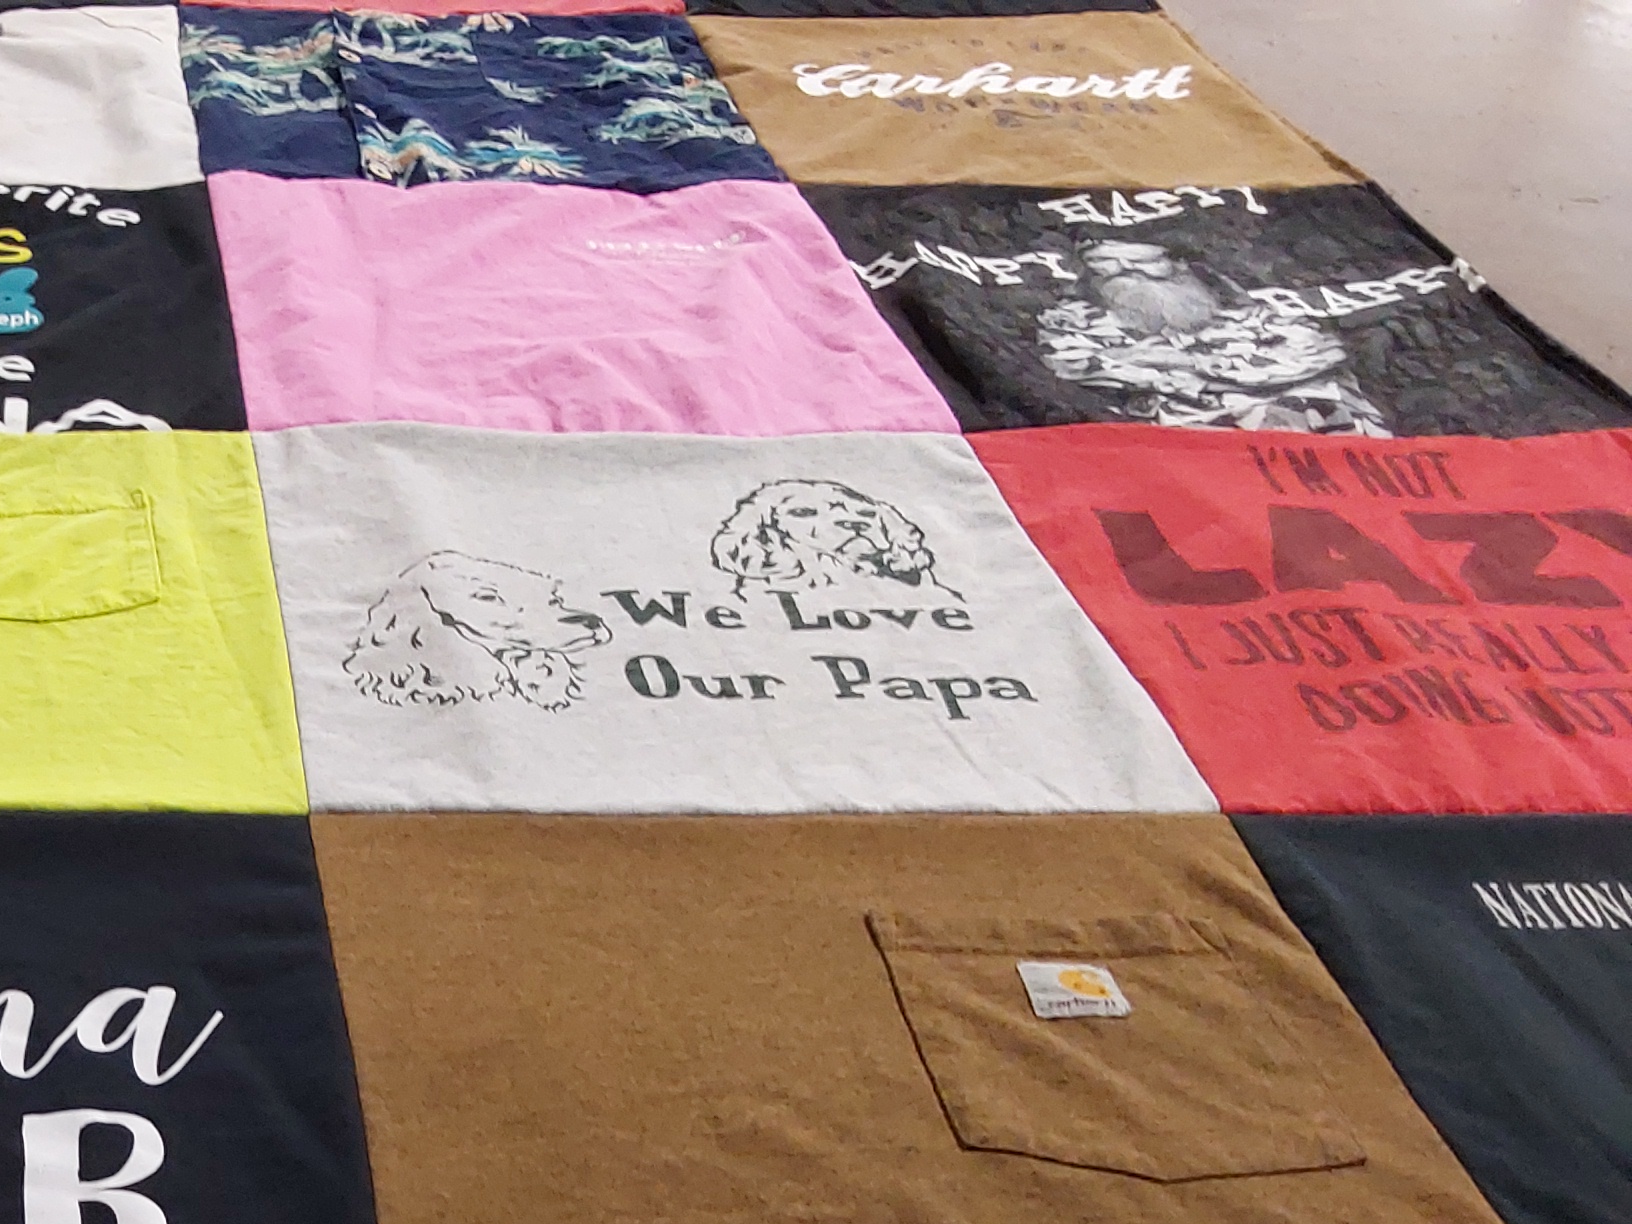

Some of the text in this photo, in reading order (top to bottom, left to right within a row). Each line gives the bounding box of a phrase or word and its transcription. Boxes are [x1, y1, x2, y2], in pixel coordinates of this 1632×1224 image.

[791, 62, 1192, 101] Carhartt
[1039, 186, 1268, 227] HAPPY
[849, 241, 1077, 289] HAPPY
[1247, 444, 1467, 499] I'M NOT
[601, 589, 975, 632] We Love
[1165, 607, 1630, 675] I JUST REALLY
[625, 655, 1038, 720] Our Papa
[1296, 665, 1512, 732] DOING
